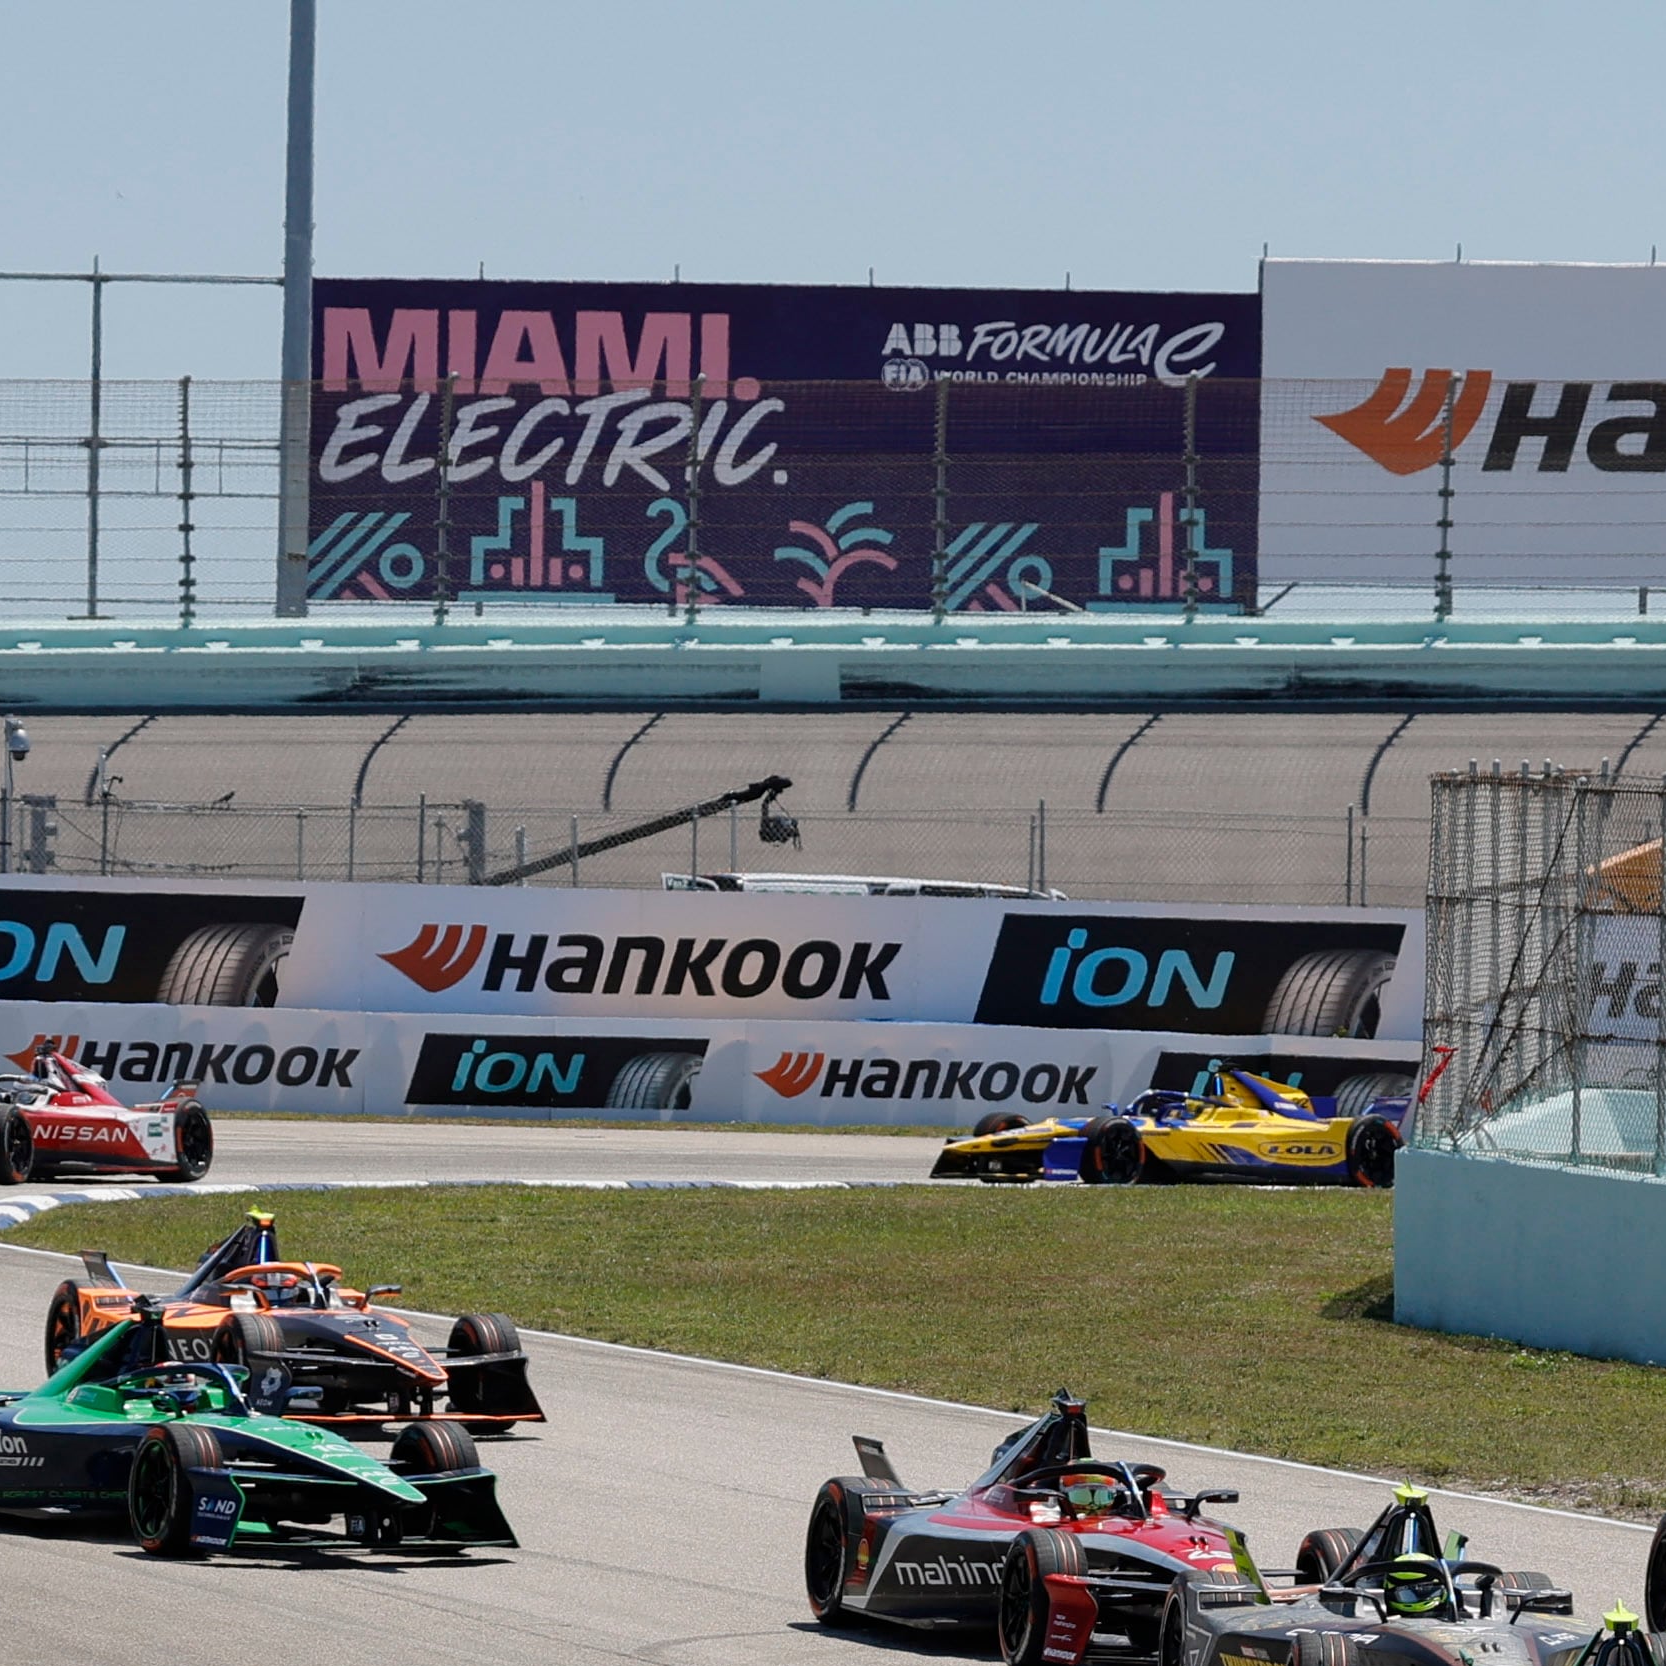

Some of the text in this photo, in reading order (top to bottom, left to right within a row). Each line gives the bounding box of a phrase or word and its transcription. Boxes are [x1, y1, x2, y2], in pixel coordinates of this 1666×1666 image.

[322, 306, 760, 402] MIAMI.
[881, 322, 964, 357] ABB
[965, 320, 1160, 366] FORMULA
[934, 370, 999, 384] WORLD
[1005, 371, 1148, 387] CHAMPIONSHIP
[319, 387, 788, 491] ELECTRIC.
[33, 1124, 129, 1142] NISSAN
[168, 1338, 213, 1361] NEO
